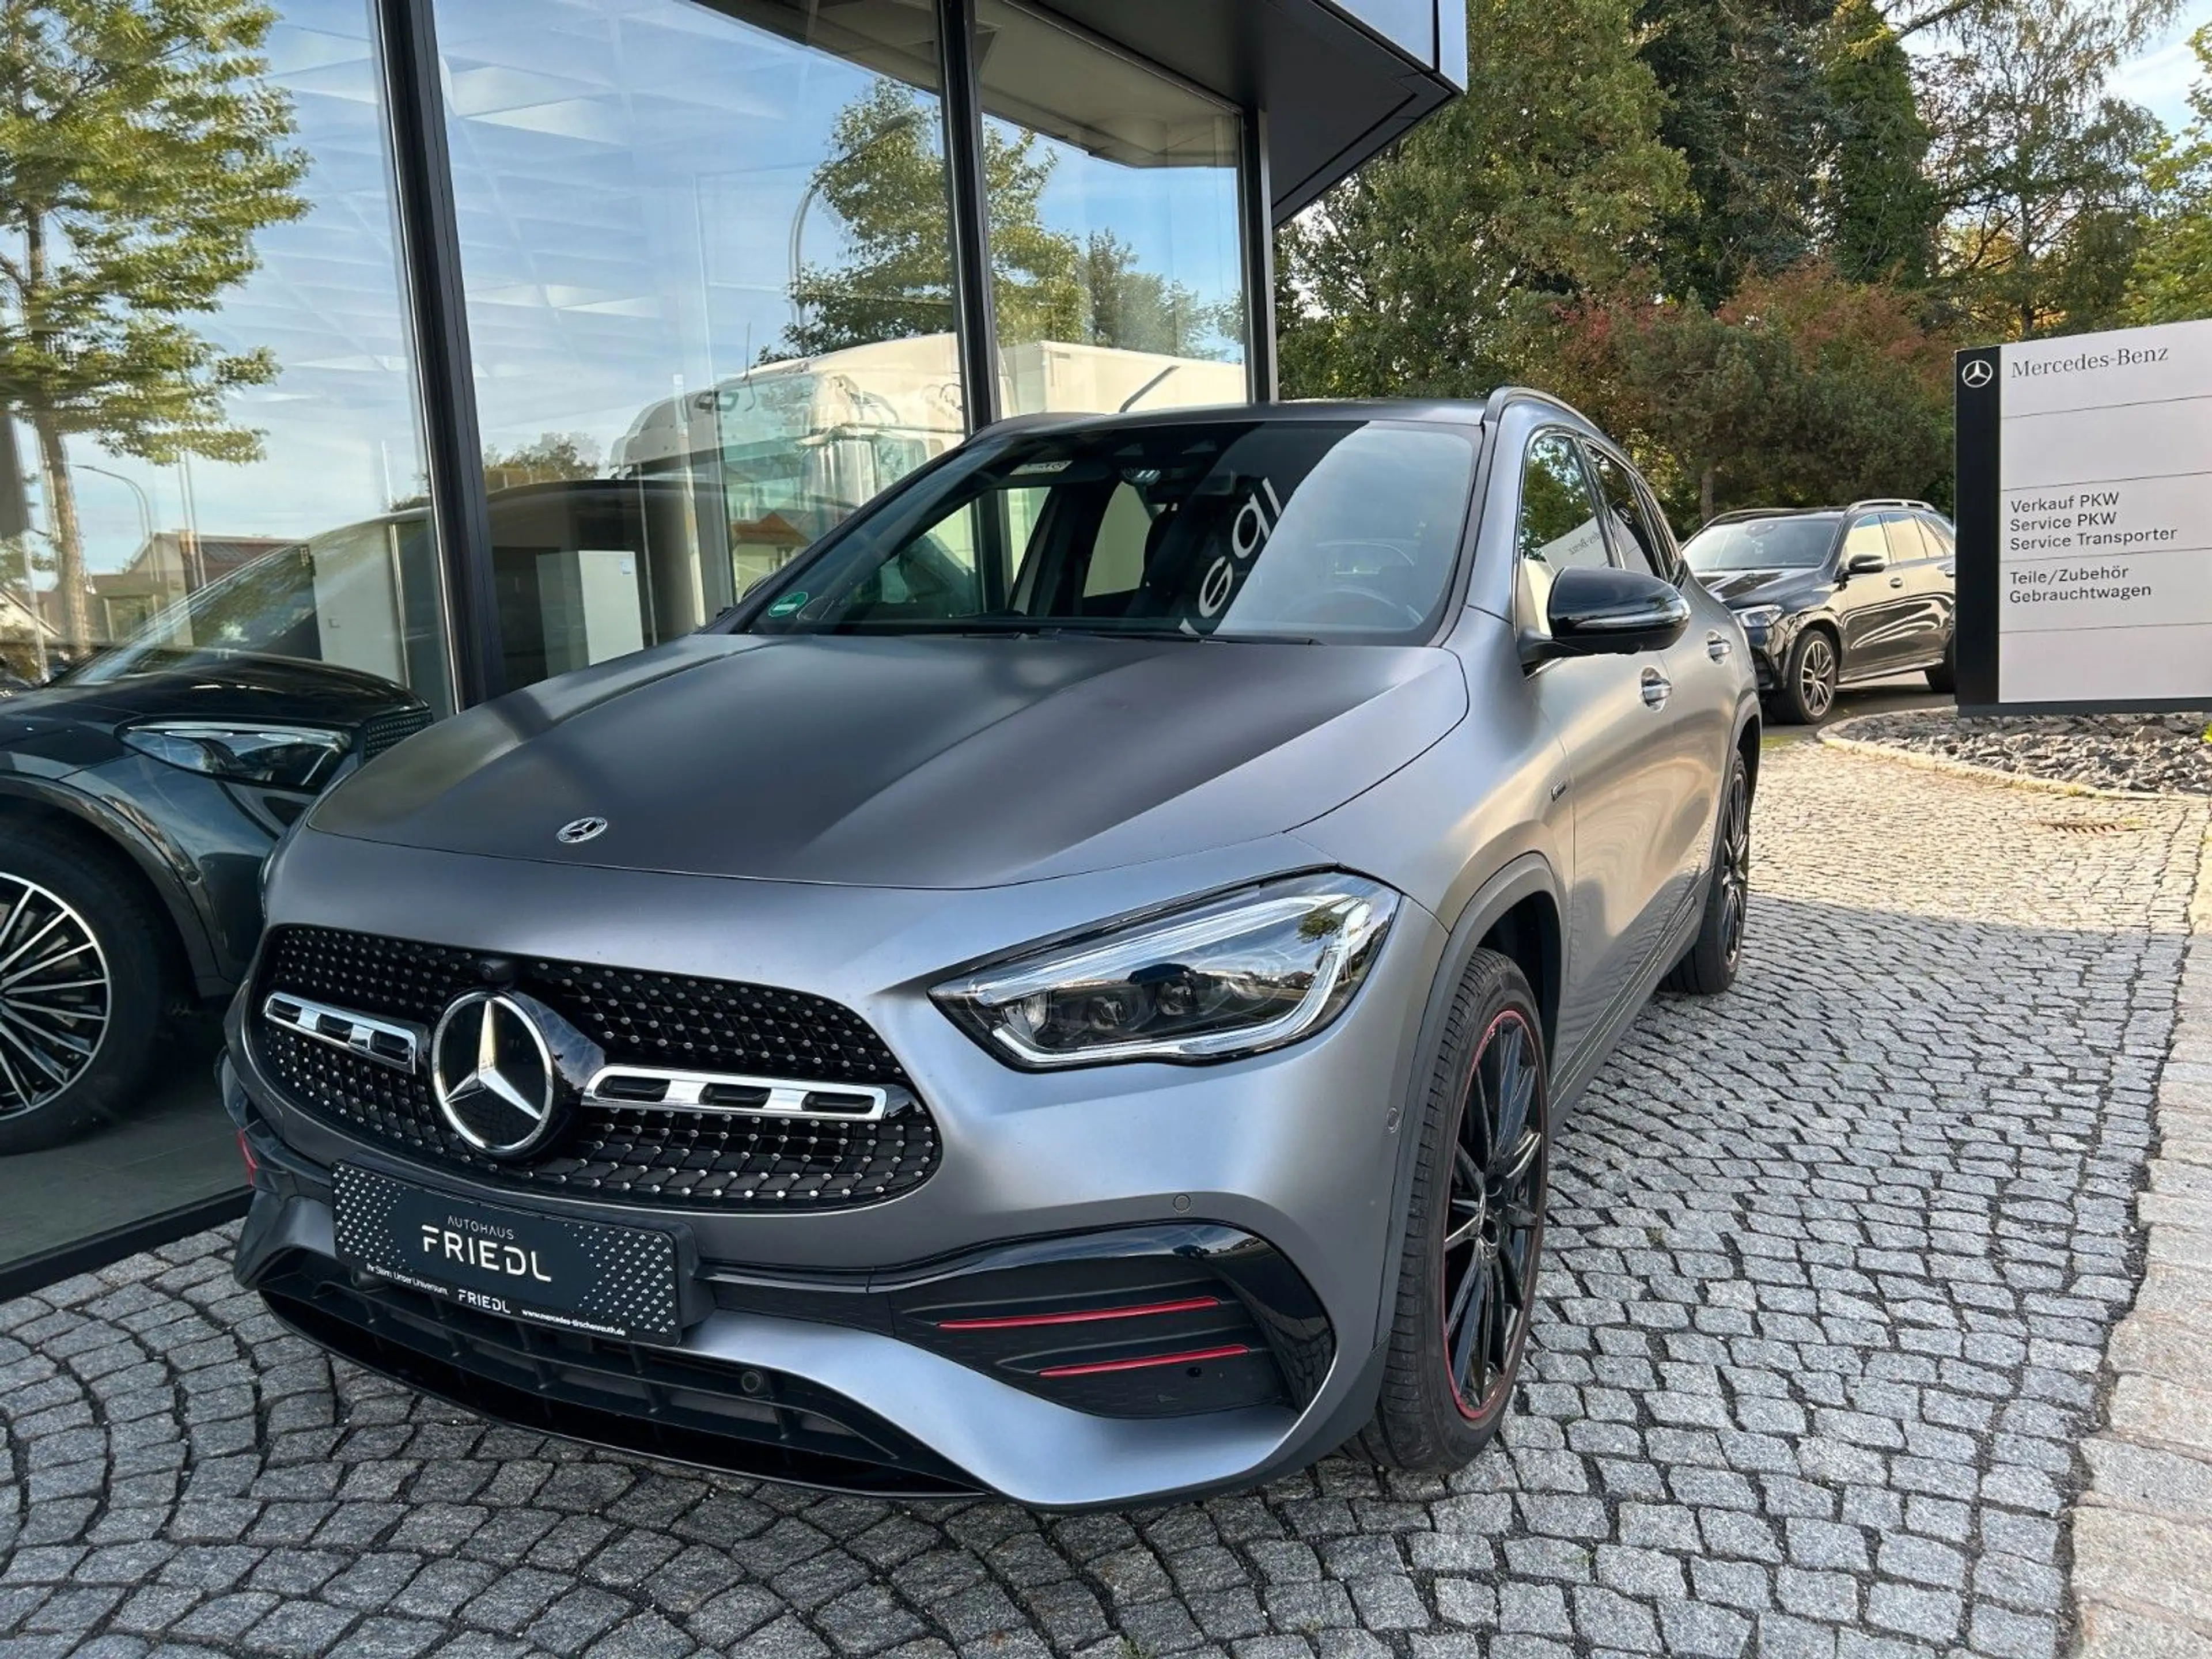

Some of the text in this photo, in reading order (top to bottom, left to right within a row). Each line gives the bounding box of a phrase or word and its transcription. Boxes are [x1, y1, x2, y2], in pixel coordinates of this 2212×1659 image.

[2011, 346, 2168, 378] Mercedes-Benz
[2010, 492, 2119, 513] Verkauf PKW
[2010, 512, 2117, 532] Service PKW
[2010, 527, 2178, 551] Service Transporter
[2010, 566, 2128, 585] Teile/Zubehör
[2009, 584, 2152, 604] Gebrauchtwagen
[447, 1215, 514, 1240] AUTOHAUS
[422, 1225, 552, 1282] FRIEDL
[458, 1289, 512, 1315] FRIEDL
